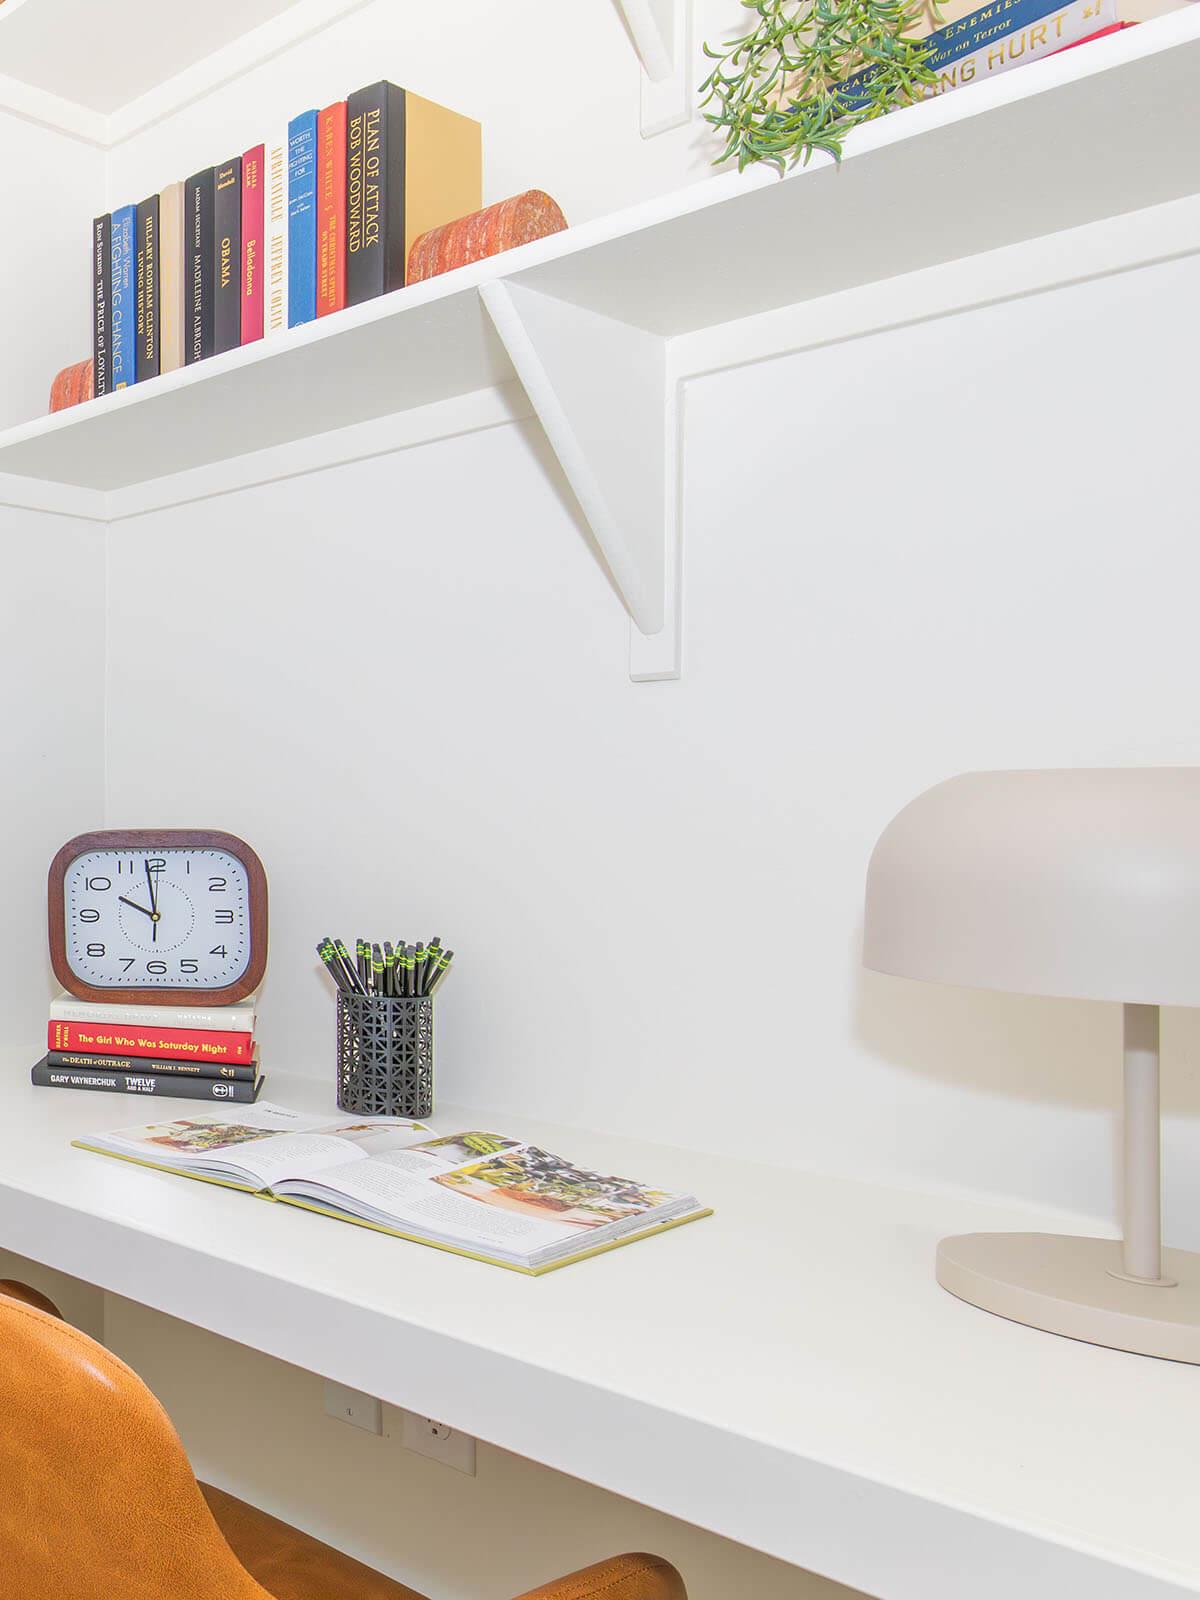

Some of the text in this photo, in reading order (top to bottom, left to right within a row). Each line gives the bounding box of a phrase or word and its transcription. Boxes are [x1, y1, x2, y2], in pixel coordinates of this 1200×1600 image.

[955, 41, 970, 51] on
[974, 18, 1012, 44] Terror
[988, 12, 1068, 70] HURT
[290, 132, 311, 147] WORTH
[294, 167, 306, 177] FOR
[325, 160, 333, 200] WHITE
[366, 108, 380, 248] PLAN OF ATTACK
[349, 115, 362, 253] BOB WOODWARD
[122, 216, 131, 289] Elizabeth Warren
[271, 235, 283, 285] JEFFREY
[111, 236, 122, 306] FIGHTING
[221, 237, 231, 289] OBAMA
[246, 239, 256, 297] Belladonna
[145, 215, 153, 360] HILLARY RODHAM CLINTON
[194, 255, 202, 313] MADELEINE
[111, 311, 123, 374] CHANCE
[194, 316, 202, 361] ALBRIGH
[118, 860, 133, 874] 11
[186, 860, 190, 874] 1
[85, 877, 112, 891] 10
[208, 877, 227, 892] 2
[79, 909, 100, 923] 9
[215, 910, 234, 924] 3
[86, 943, 106, 957] 8
[209, 944, 228, 959] 4
[118, 958, 136, 972] 7
[146, 960, 167, 975] 6
[180, 959, 198, 973] 5
[78, 1034, 93, 1044] The
[95, 1035, 112, 1045] Girl
[115, 1037, 135, 1047] Who
[138, 1039, 157, 1049] Was
[158, 1040, 199, 1053] Saturday
[201, 1043, 227, 1056] Night
[70, 1057, 92, 1065] DEATH
[98, 1060, 131, 1068] OUTRAGE
[50, 1074, 156, 1087] GARY VAYNERCHUK TWELVE
